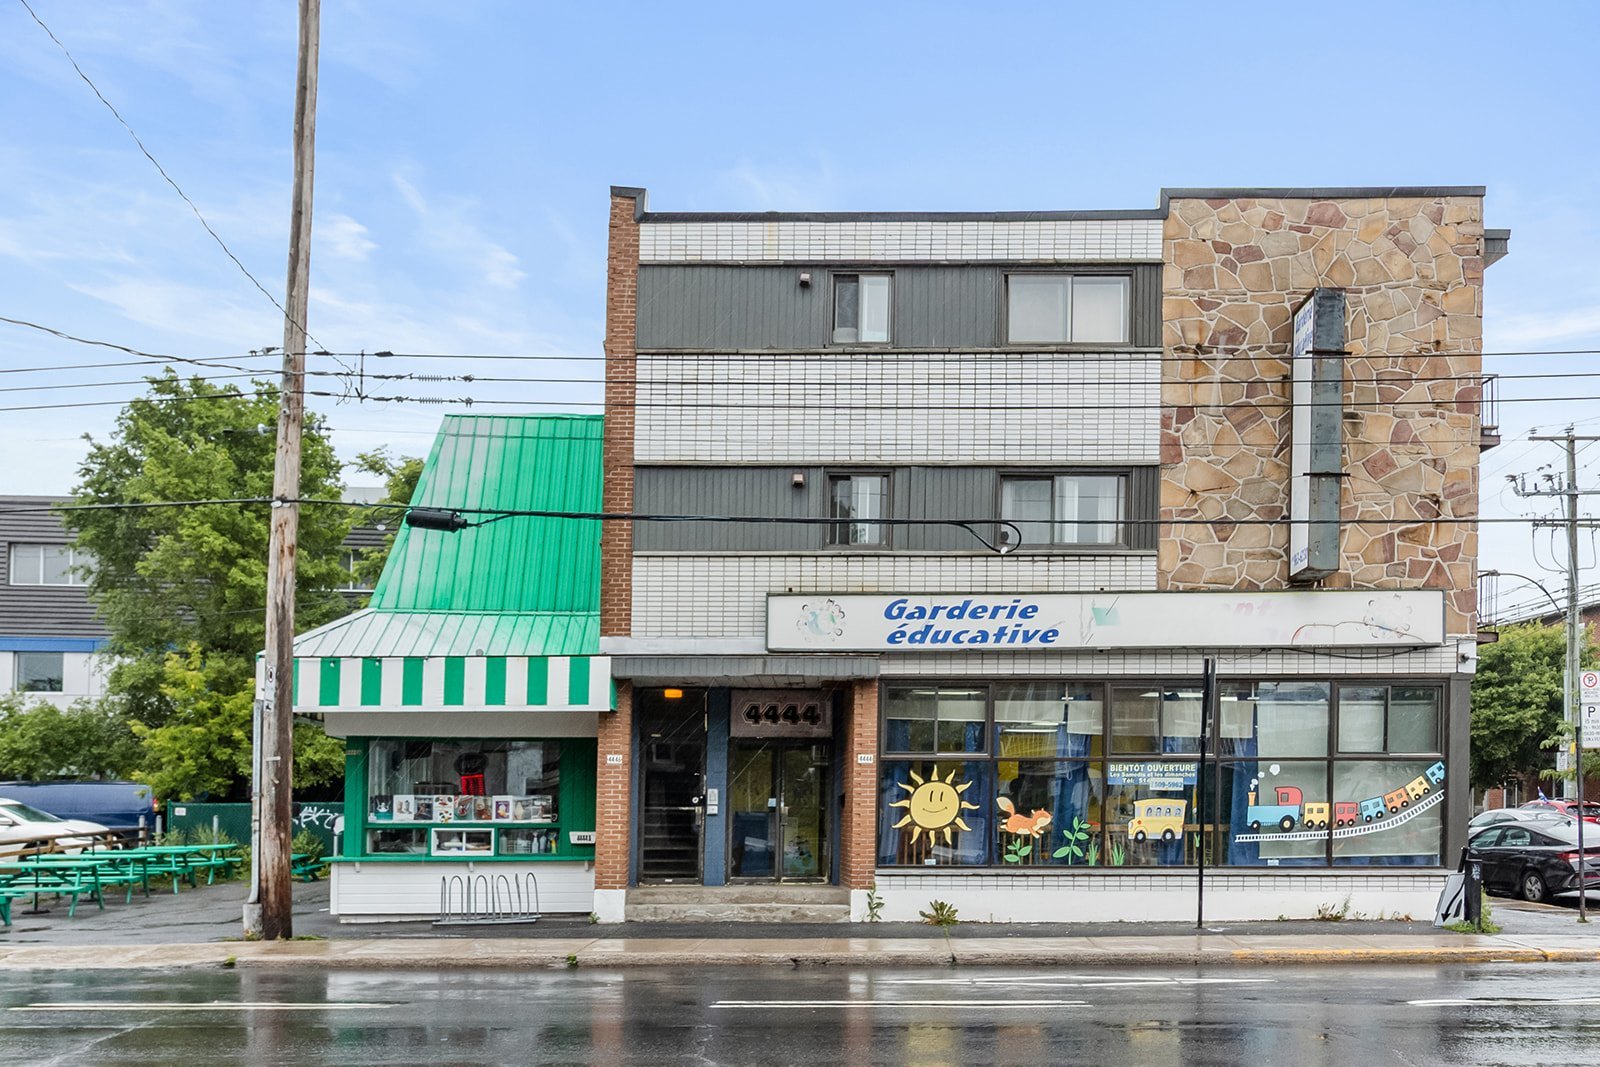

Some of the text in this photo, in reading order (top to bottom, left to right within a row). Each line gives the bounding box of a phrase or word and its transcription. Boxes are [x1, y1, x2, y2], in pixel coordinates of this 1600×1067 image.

[884, 598, 1039, 620] Garderie
[886, 623, 1060, 645] éducative
[743, 702, 821, 726] 4444
[1588, 706, 1596, 718] P
[1110, 763, 1196, 772] BIENTÔT OUVERTURE
